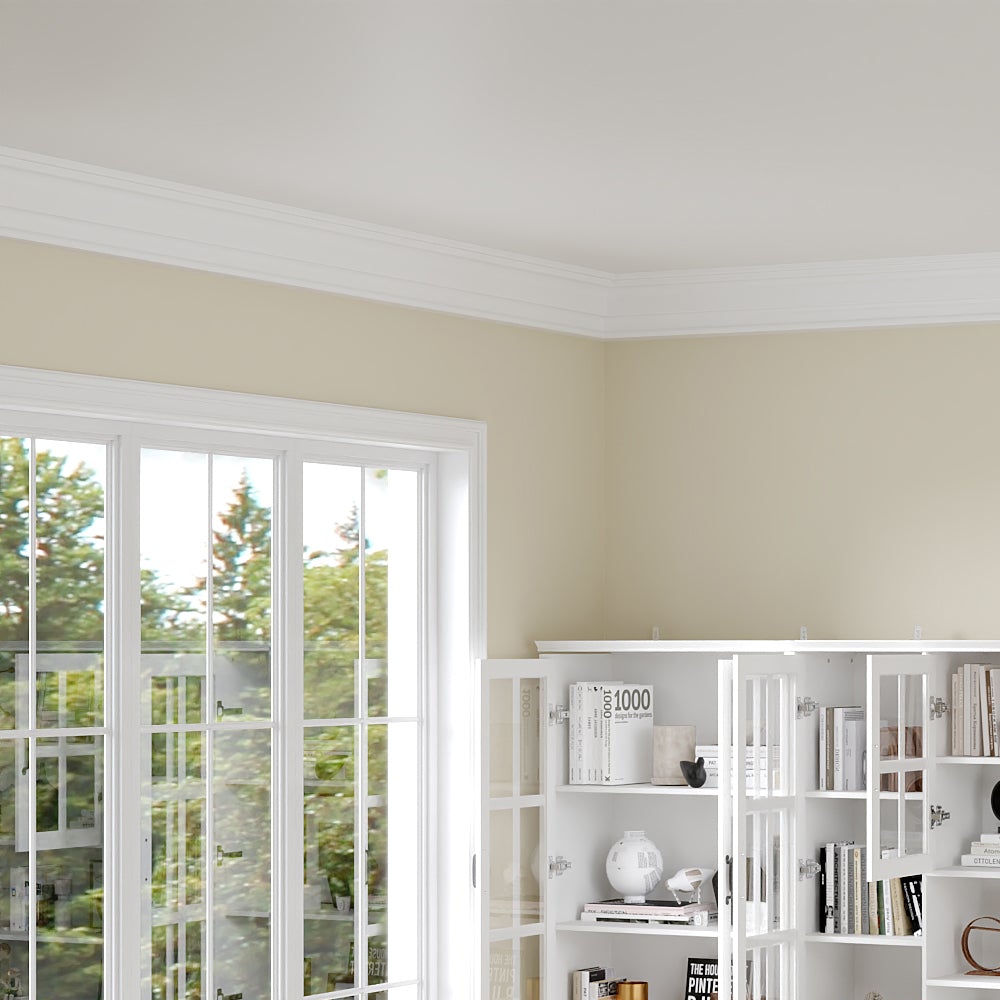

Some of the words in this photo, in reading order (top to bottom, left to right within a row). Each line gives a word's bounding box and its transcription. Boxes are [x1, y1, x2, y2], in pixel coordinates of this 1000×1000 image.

[603, 689, 612, 718] 1000
[614, 689, 650, 711] 1000
[690, 963, 704, 975] THE
[705, 964, 718, 976] HOU
[688, 977, 718, 994] PINTE
